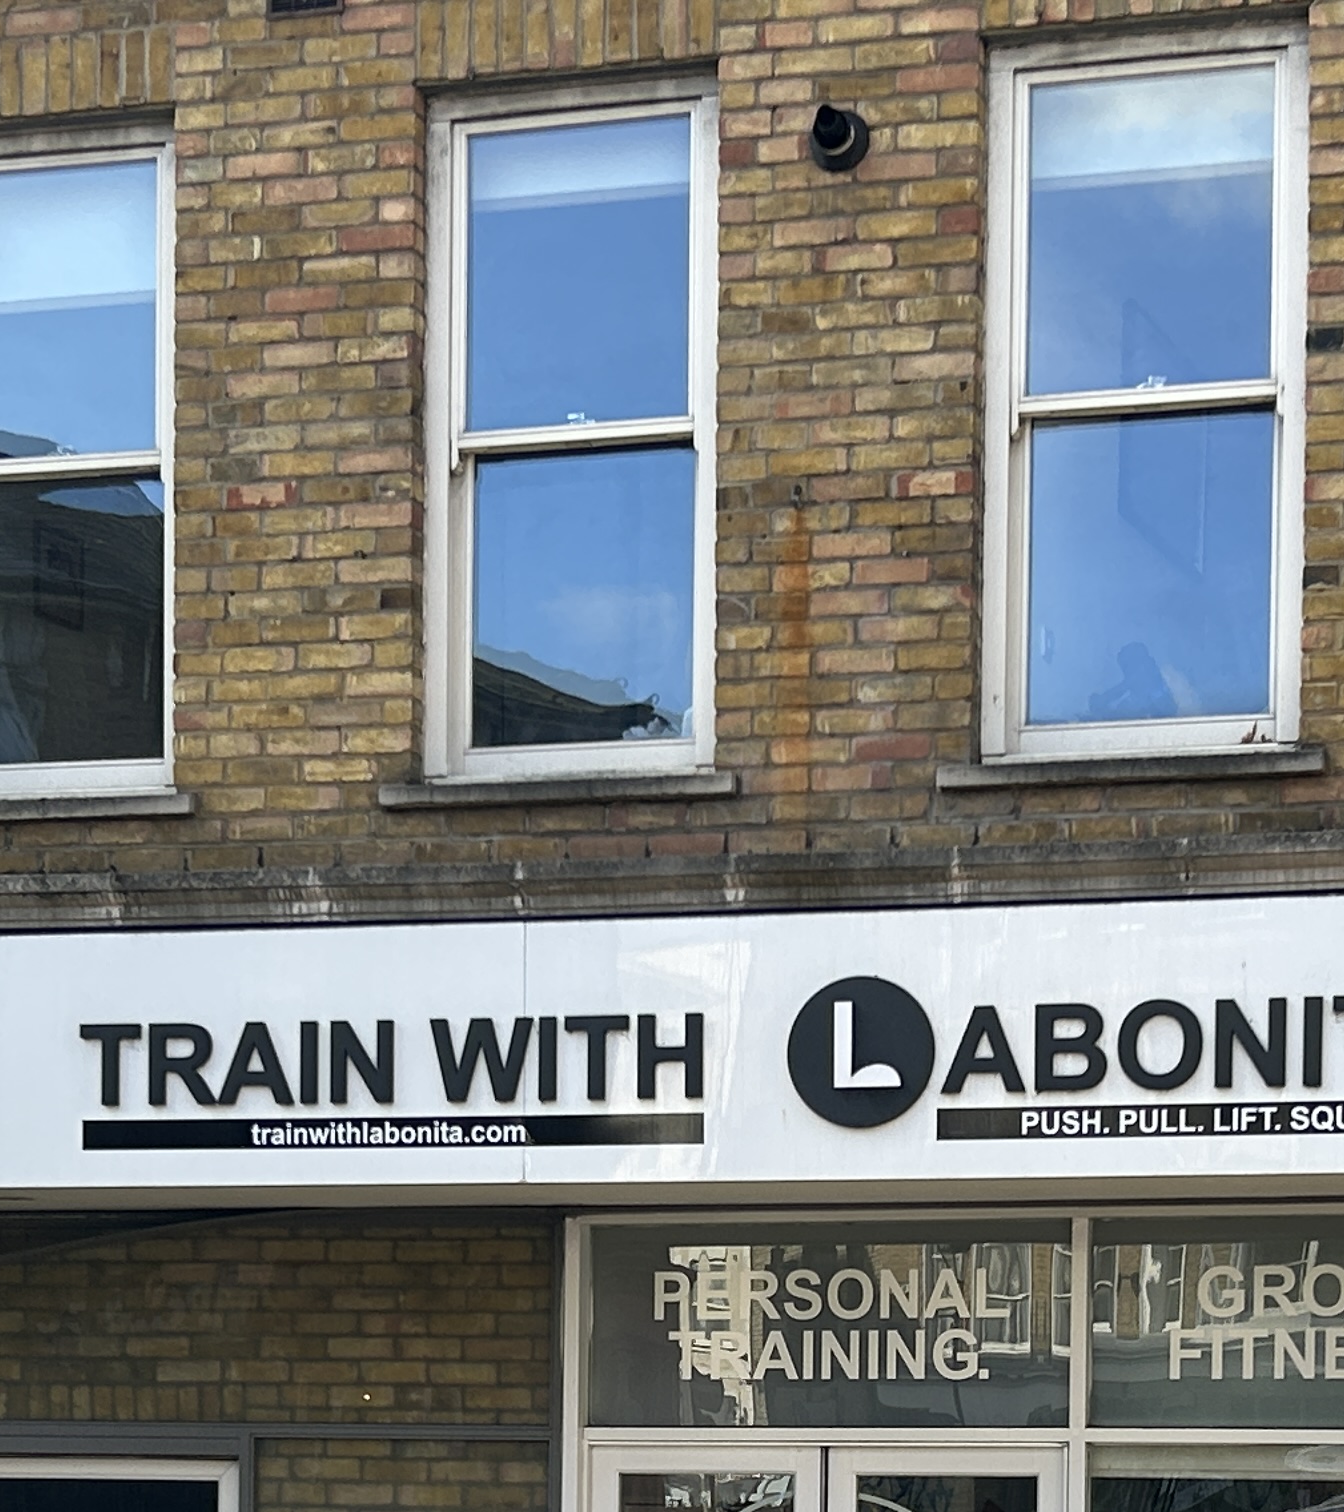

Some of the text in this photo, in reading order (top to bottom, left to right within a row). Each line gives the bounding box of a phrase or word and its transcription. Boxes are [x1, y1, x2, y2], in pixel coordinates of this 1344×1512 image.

[79, 1012, 705, 1107] TRAIN WITH
[251, 1121, 525, 1147] trainwithlabonita.com
[1021, 1108, 1108, 1136] PUSH.
[1118, 1107, 1204, 1135] PULL.
[1214, 1106, 1282, 1134] LIFT.
[653, 1266, 1010, 1321] PERSONAL
[668, 1329, 990, 1381] TRAINING.
